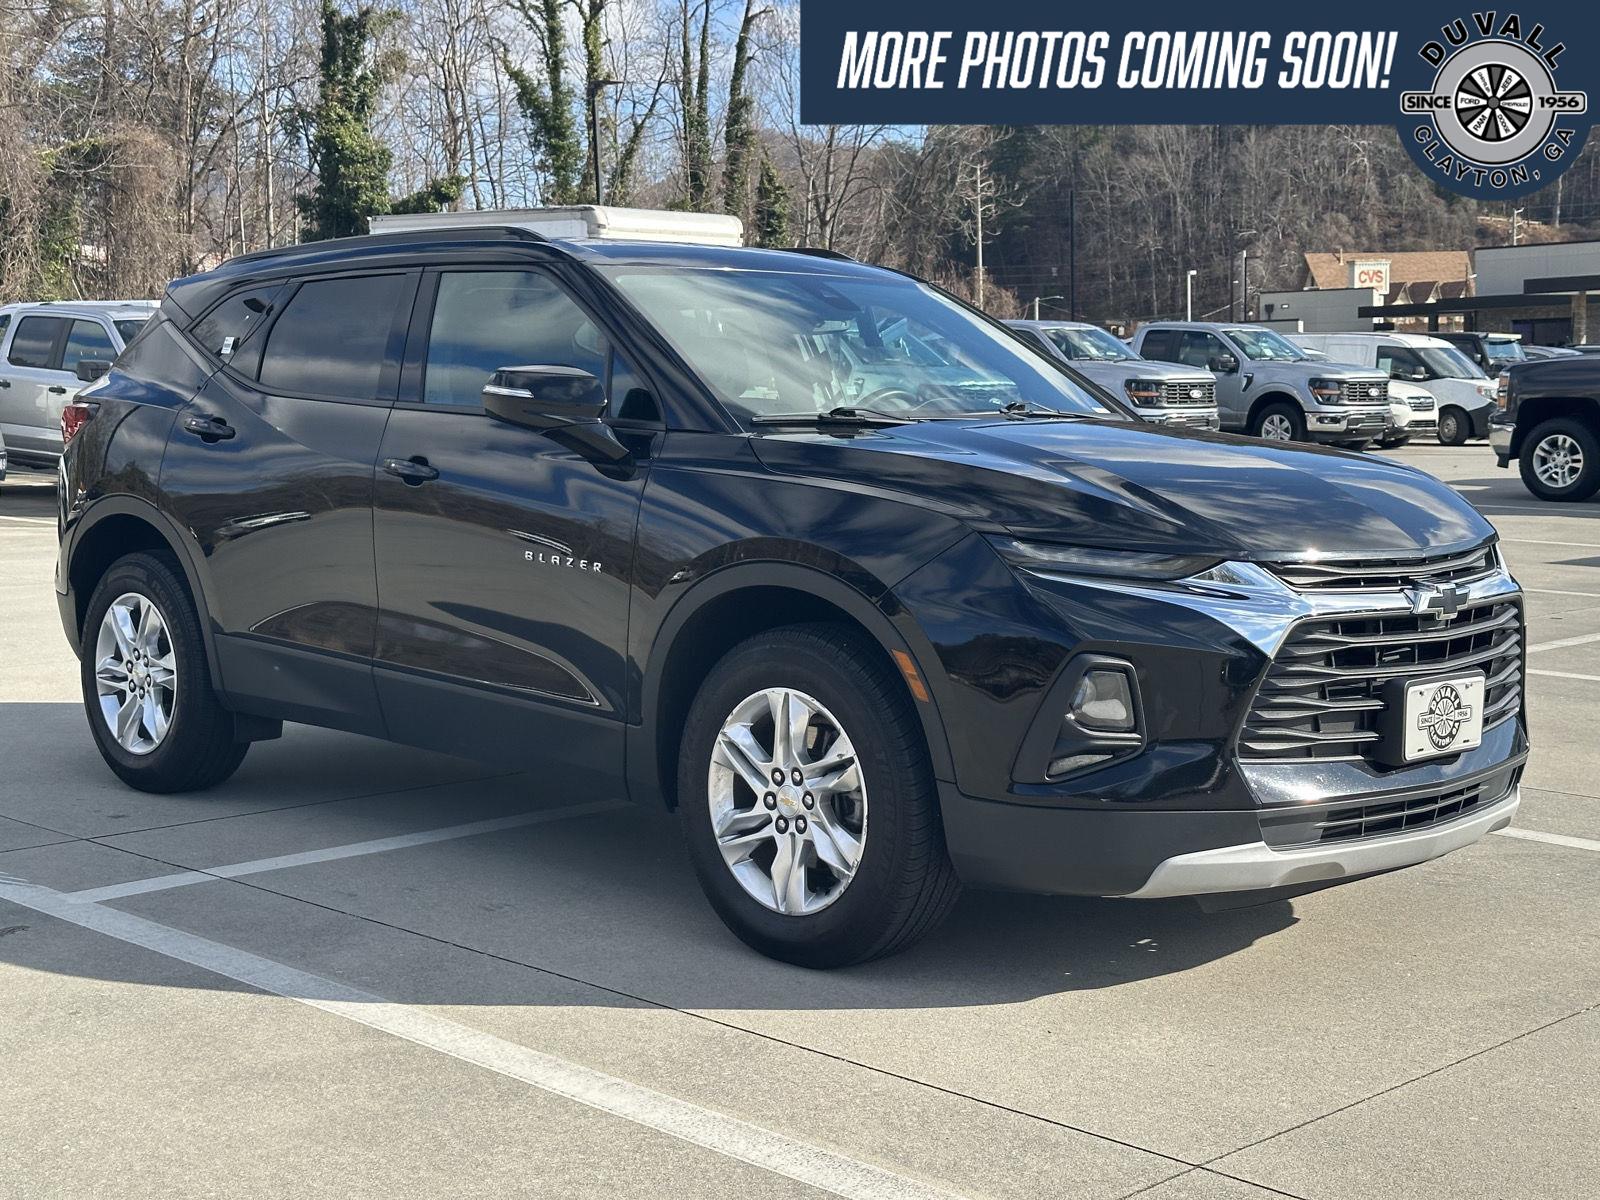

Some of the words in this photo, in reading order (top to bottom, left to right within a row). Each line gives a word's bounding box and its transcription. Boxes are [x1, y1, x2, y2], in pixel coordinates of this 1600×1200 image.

[1358, 270, 1384, 283] CVS
[524, 550, 602, 573] BLAZER
[1431, 687, 1461, 711] DUVALL
